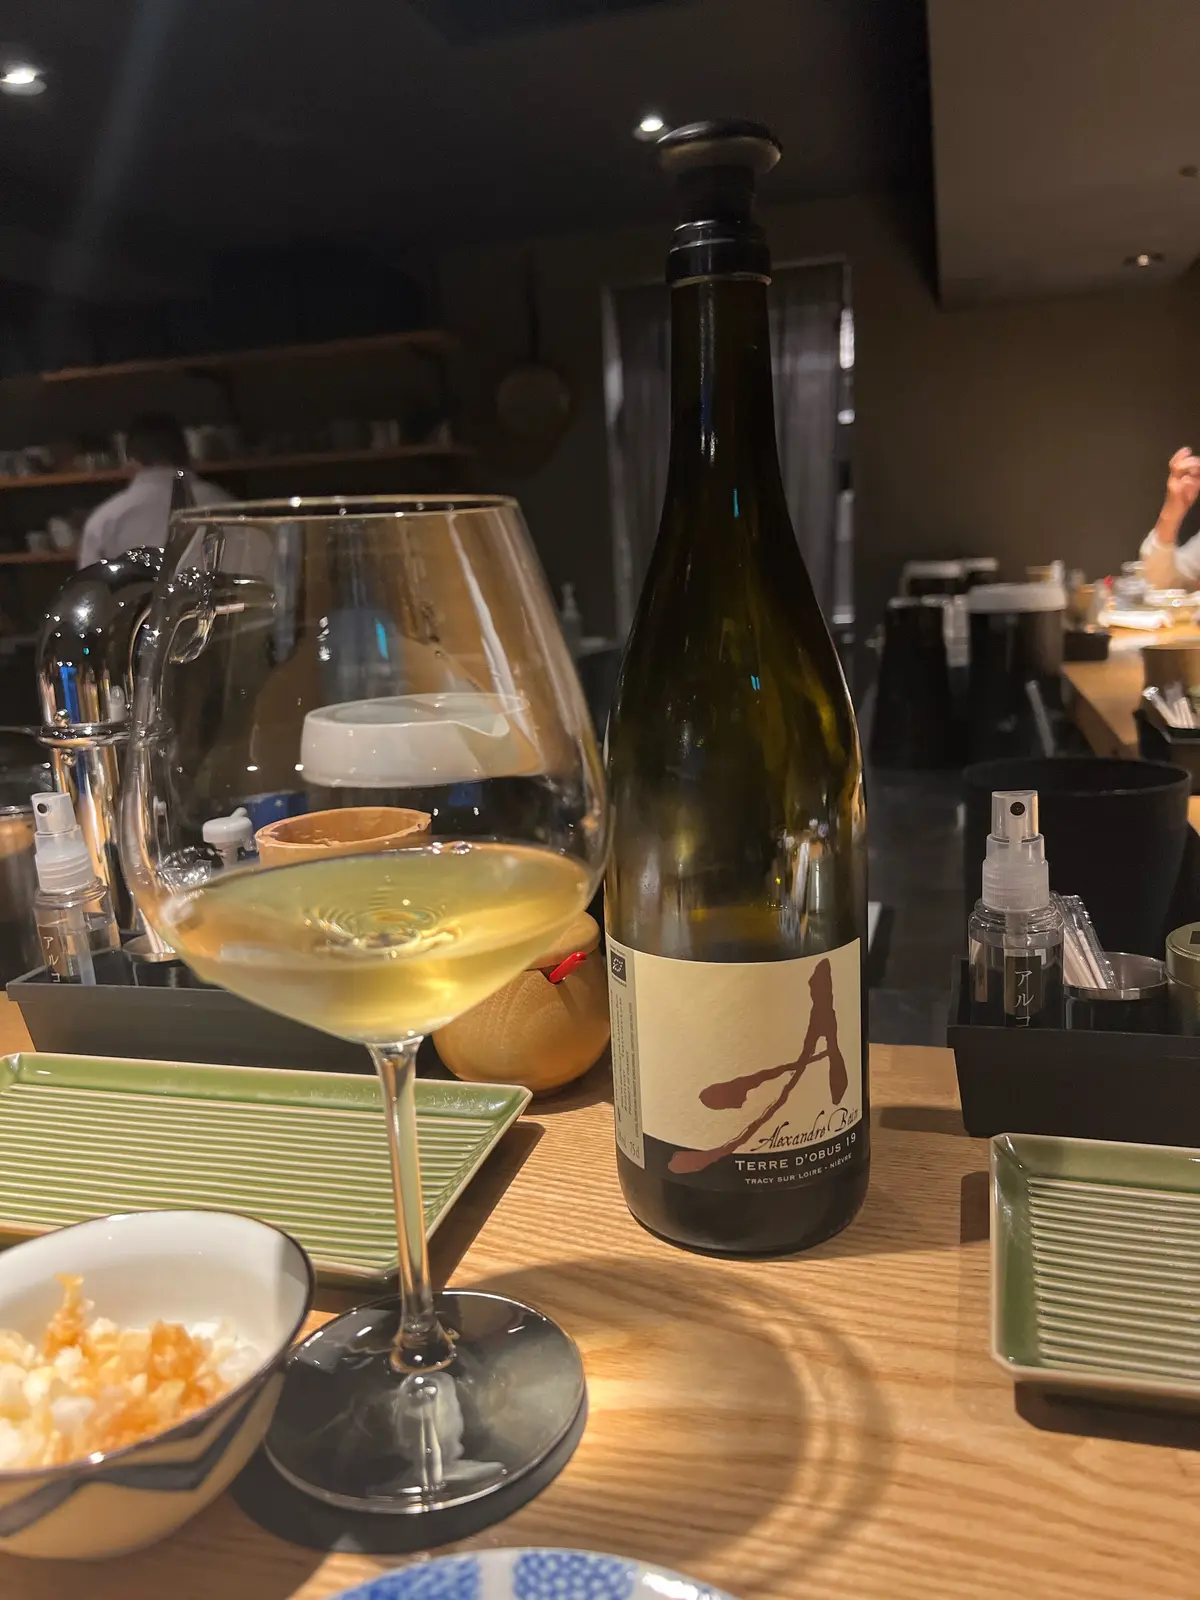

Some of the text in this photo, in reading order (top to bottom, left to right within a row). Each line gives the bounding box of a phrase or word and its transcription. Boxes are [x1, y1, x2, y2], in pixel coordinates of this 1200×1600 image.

[750, 1110, 826, 1152] Alexandre
[734, 1132, 857, 1172] TERRE D'OBUS 19
[744, 1177, 774, 1185] TRACY
[777, 1174, 796, 1183] SUR
[798, 1166, 823, 1180] LOIRE
[829, 1152, 853, 1169] NIÈVRE
